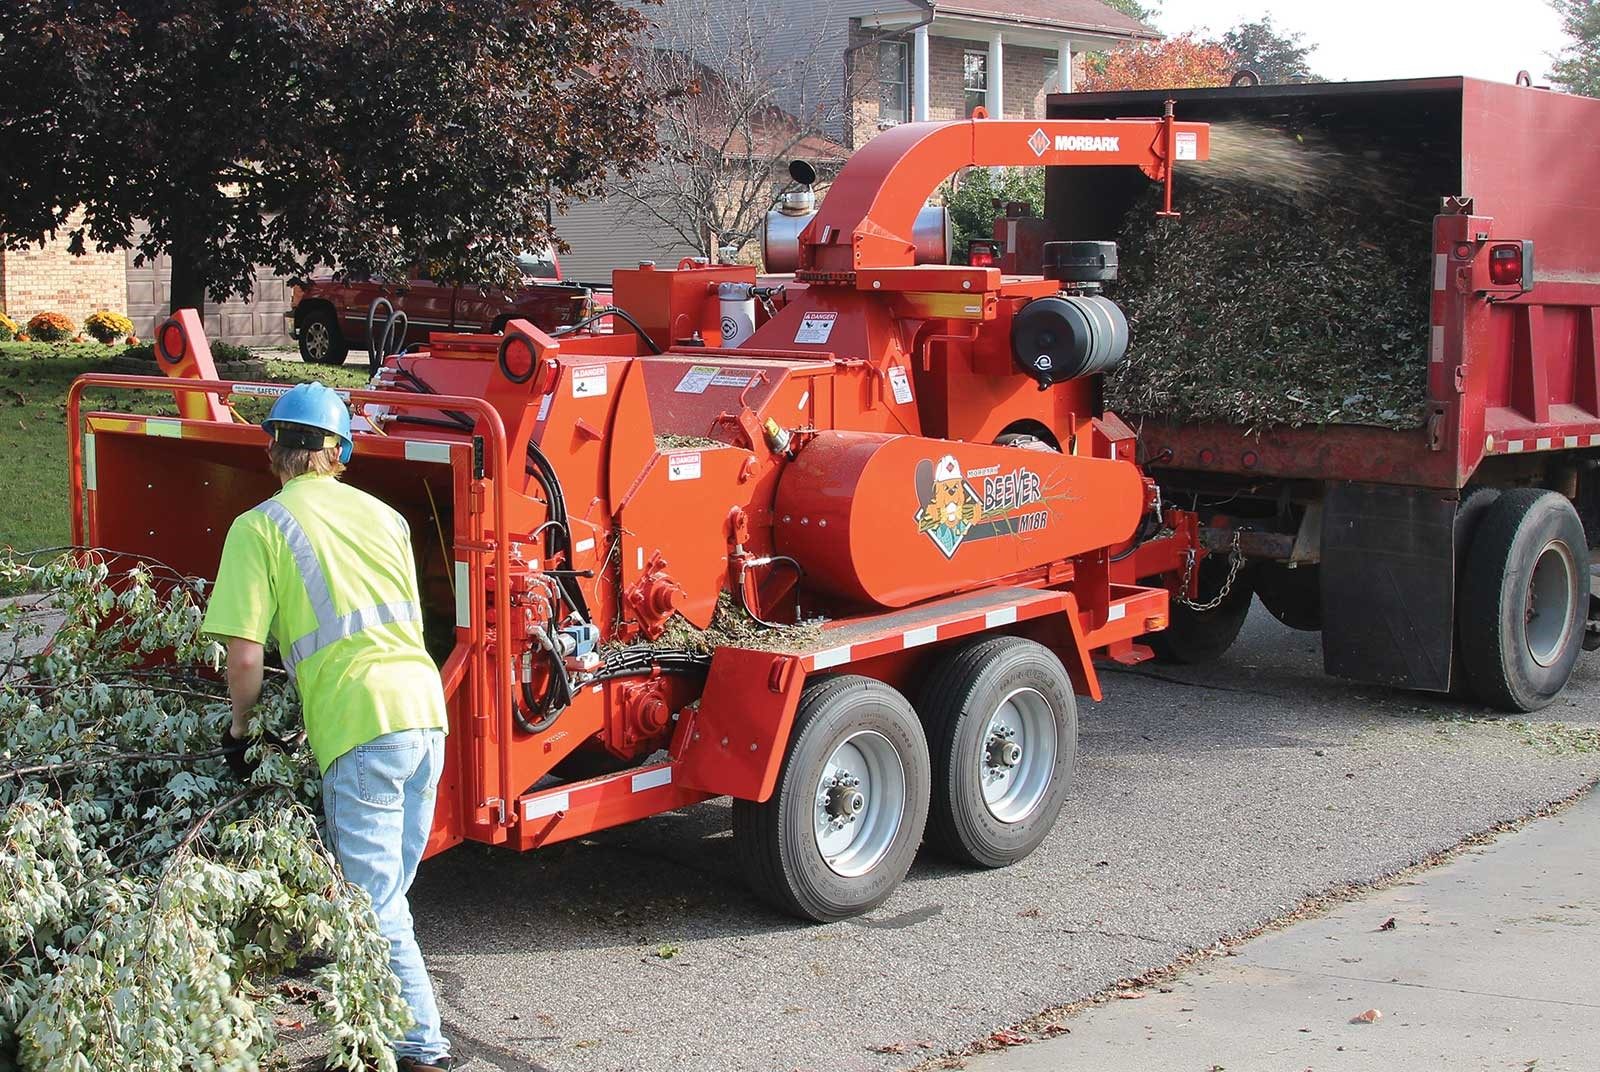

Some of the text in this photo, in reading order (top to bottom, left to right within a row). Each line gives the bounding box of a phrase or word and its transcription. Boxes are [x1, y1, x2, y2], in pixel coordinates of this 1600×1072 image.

[1055, 136, 1119, 152] MORBARK
[580, 367, 605, 377] DANGER
[256, 385, 279, 395] SAFETY
[984, 467, 1041, 512] BEEVER
[1019, 511, 1048, 534] M18R
